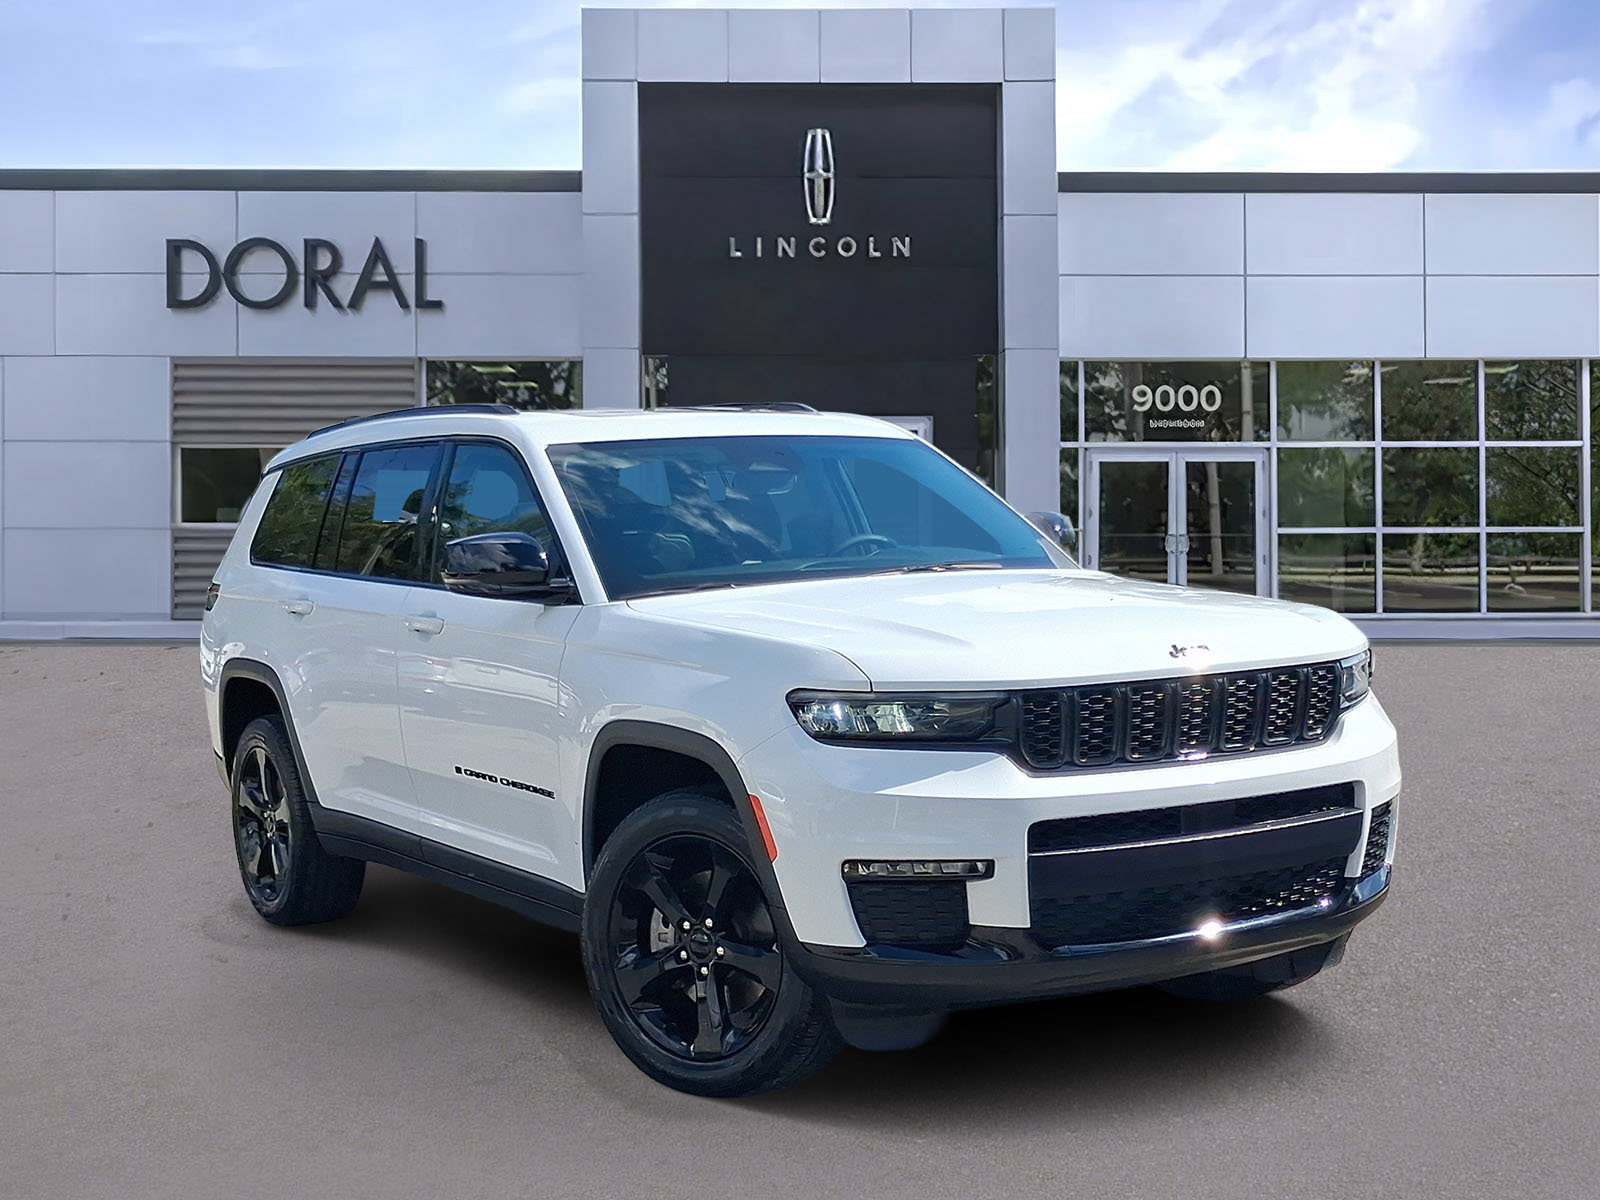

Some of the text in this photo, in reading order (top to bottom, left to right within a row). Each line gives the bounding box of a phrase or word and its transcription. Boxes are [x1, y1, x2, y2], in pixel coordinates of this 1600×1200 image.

[728, 236, 911, 258] LINCOLN
[166, 236, 444, 310] DORAL
[1132, 384, 1222, 412] 9000
[1169, 643, 1211, 660] Je
